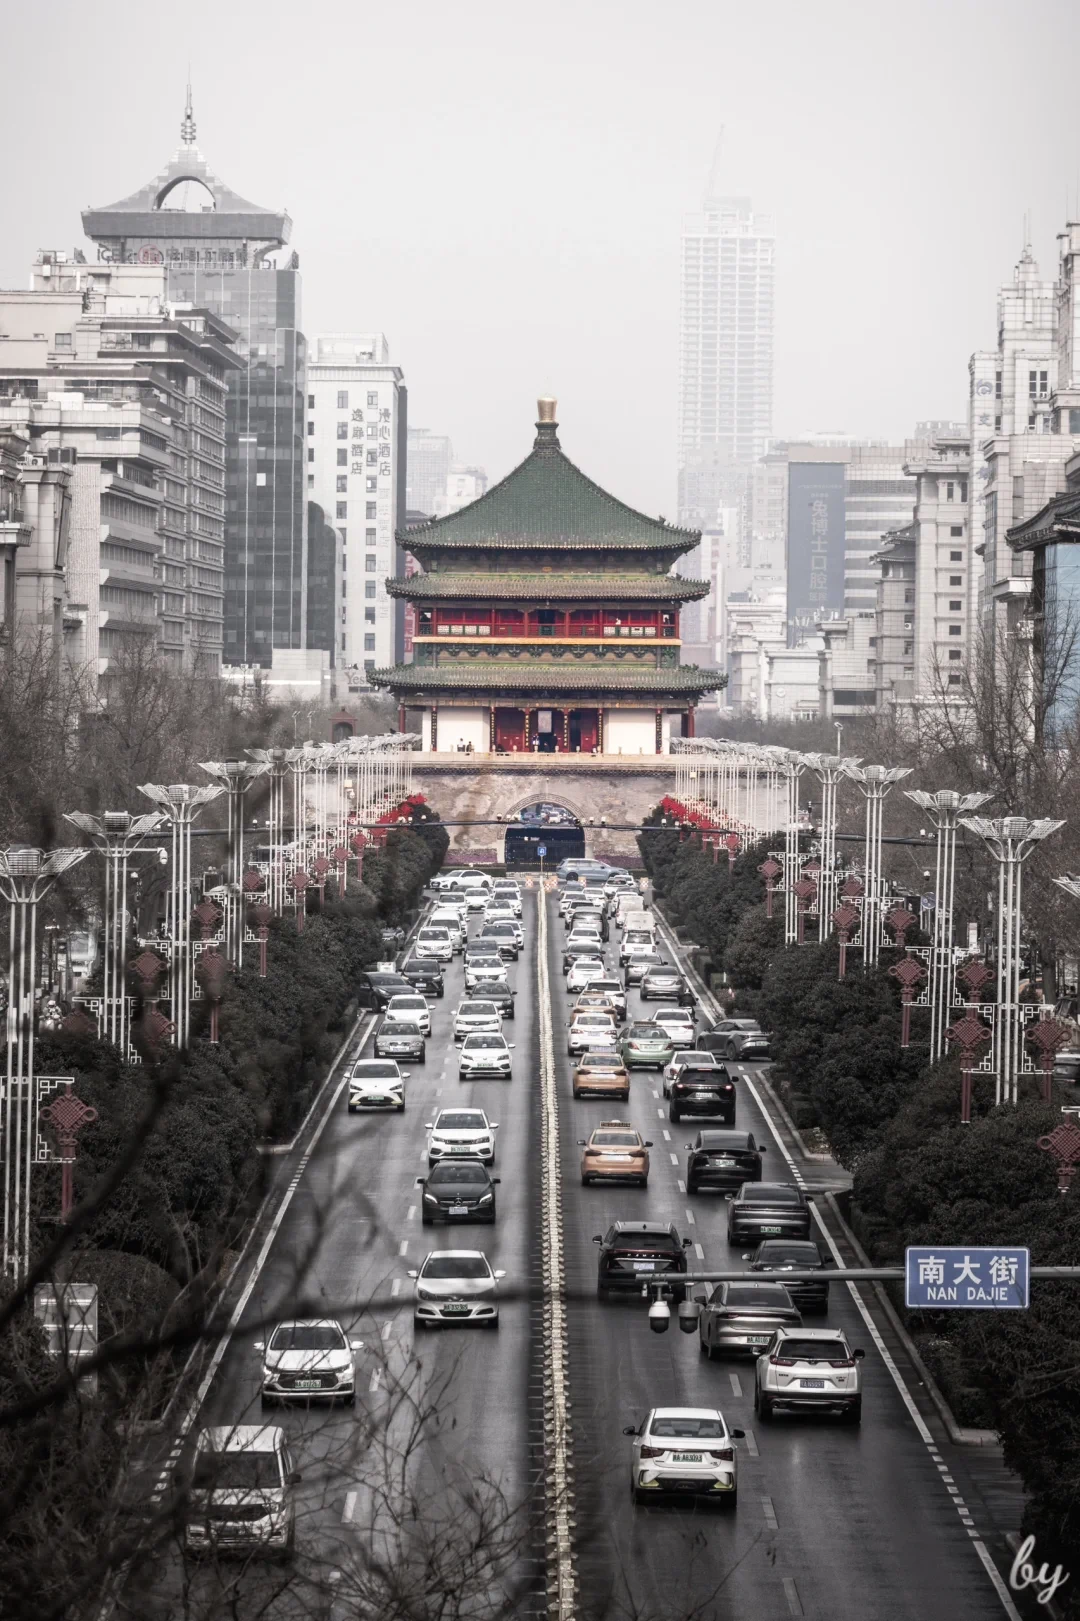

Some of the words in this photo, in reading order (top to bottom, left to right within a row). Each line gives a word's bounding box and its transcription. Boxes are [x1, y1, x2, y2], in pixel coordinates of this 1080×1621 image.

[378, 408, 391, 476] 漫心酒店
[918, 1255, 1018, 1285] 南大街
[927, 1287, 957, 1301] NAN
[967, 1287, 1008, 1301] DAJIE
